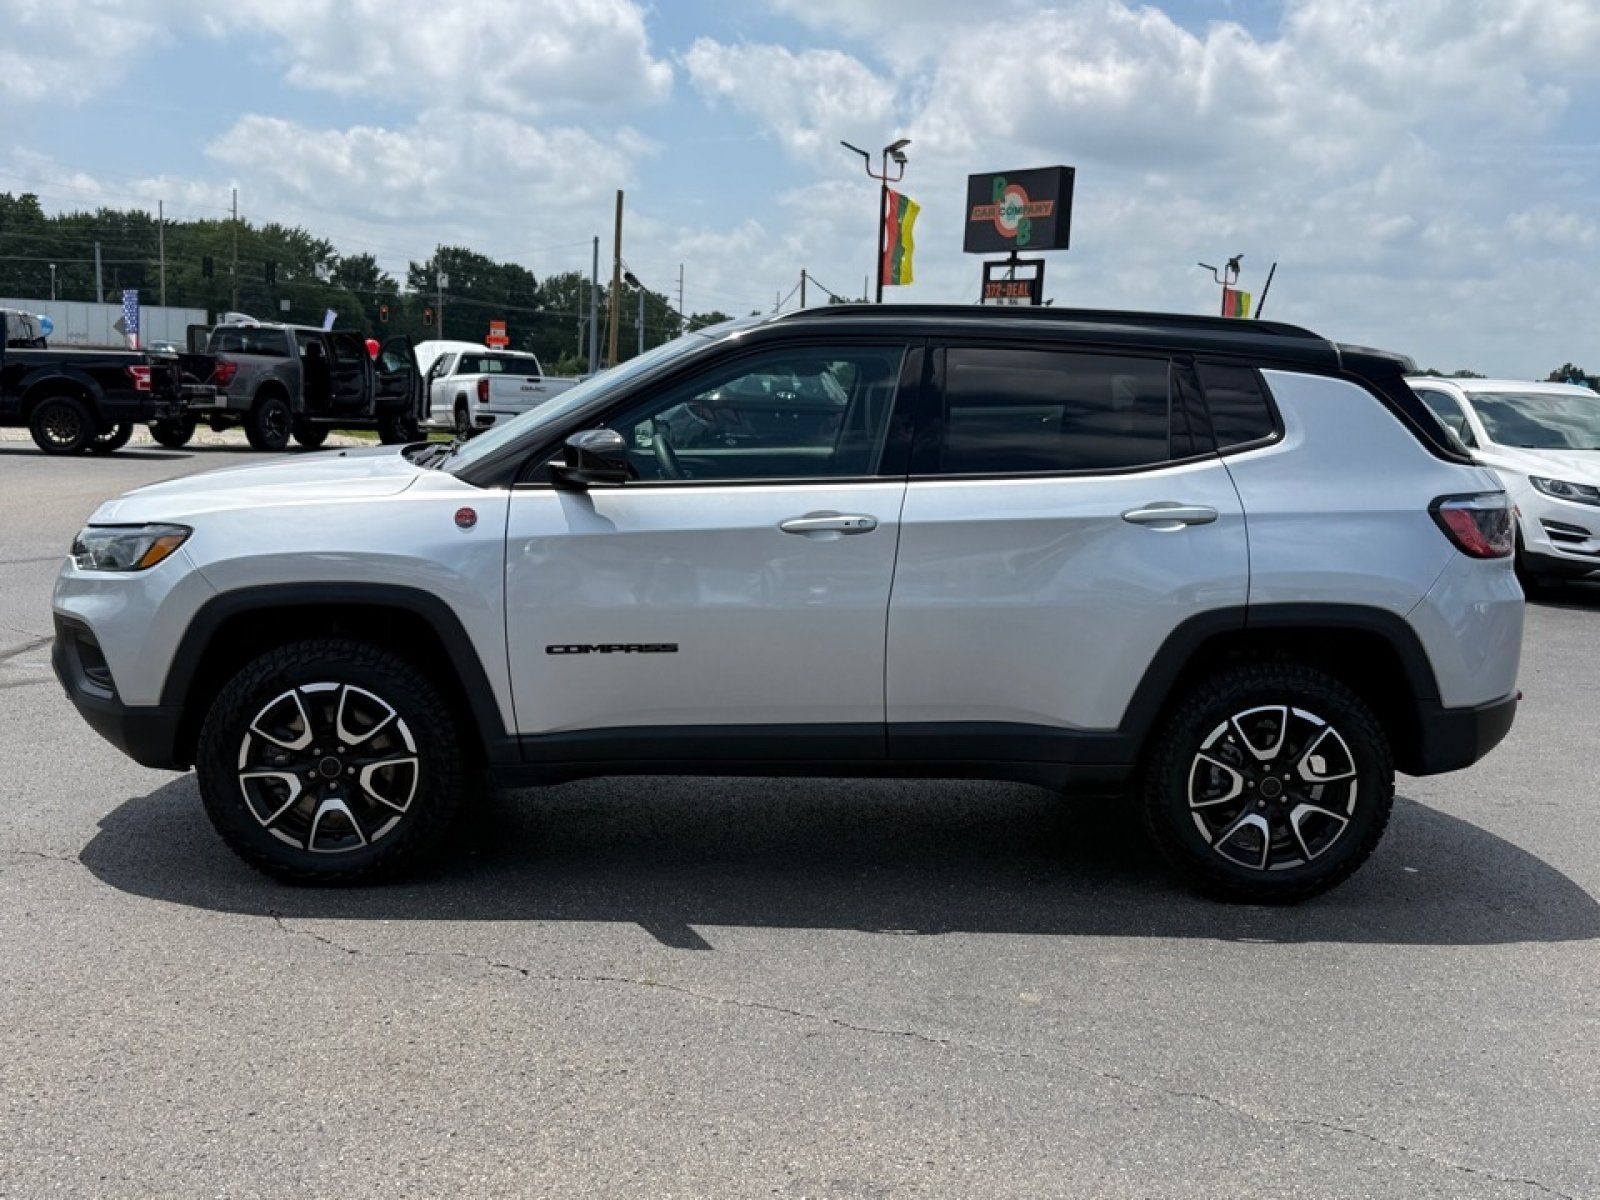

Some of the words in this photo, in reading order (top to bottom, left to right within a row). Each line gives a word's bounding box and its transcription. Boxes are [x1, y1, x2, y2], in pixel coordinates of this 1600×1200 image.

[973, 206, 996, 217] CAR
[1000, 203, 1050, 217] COMPANY
[546, 644, 678, 654] COMPASS
